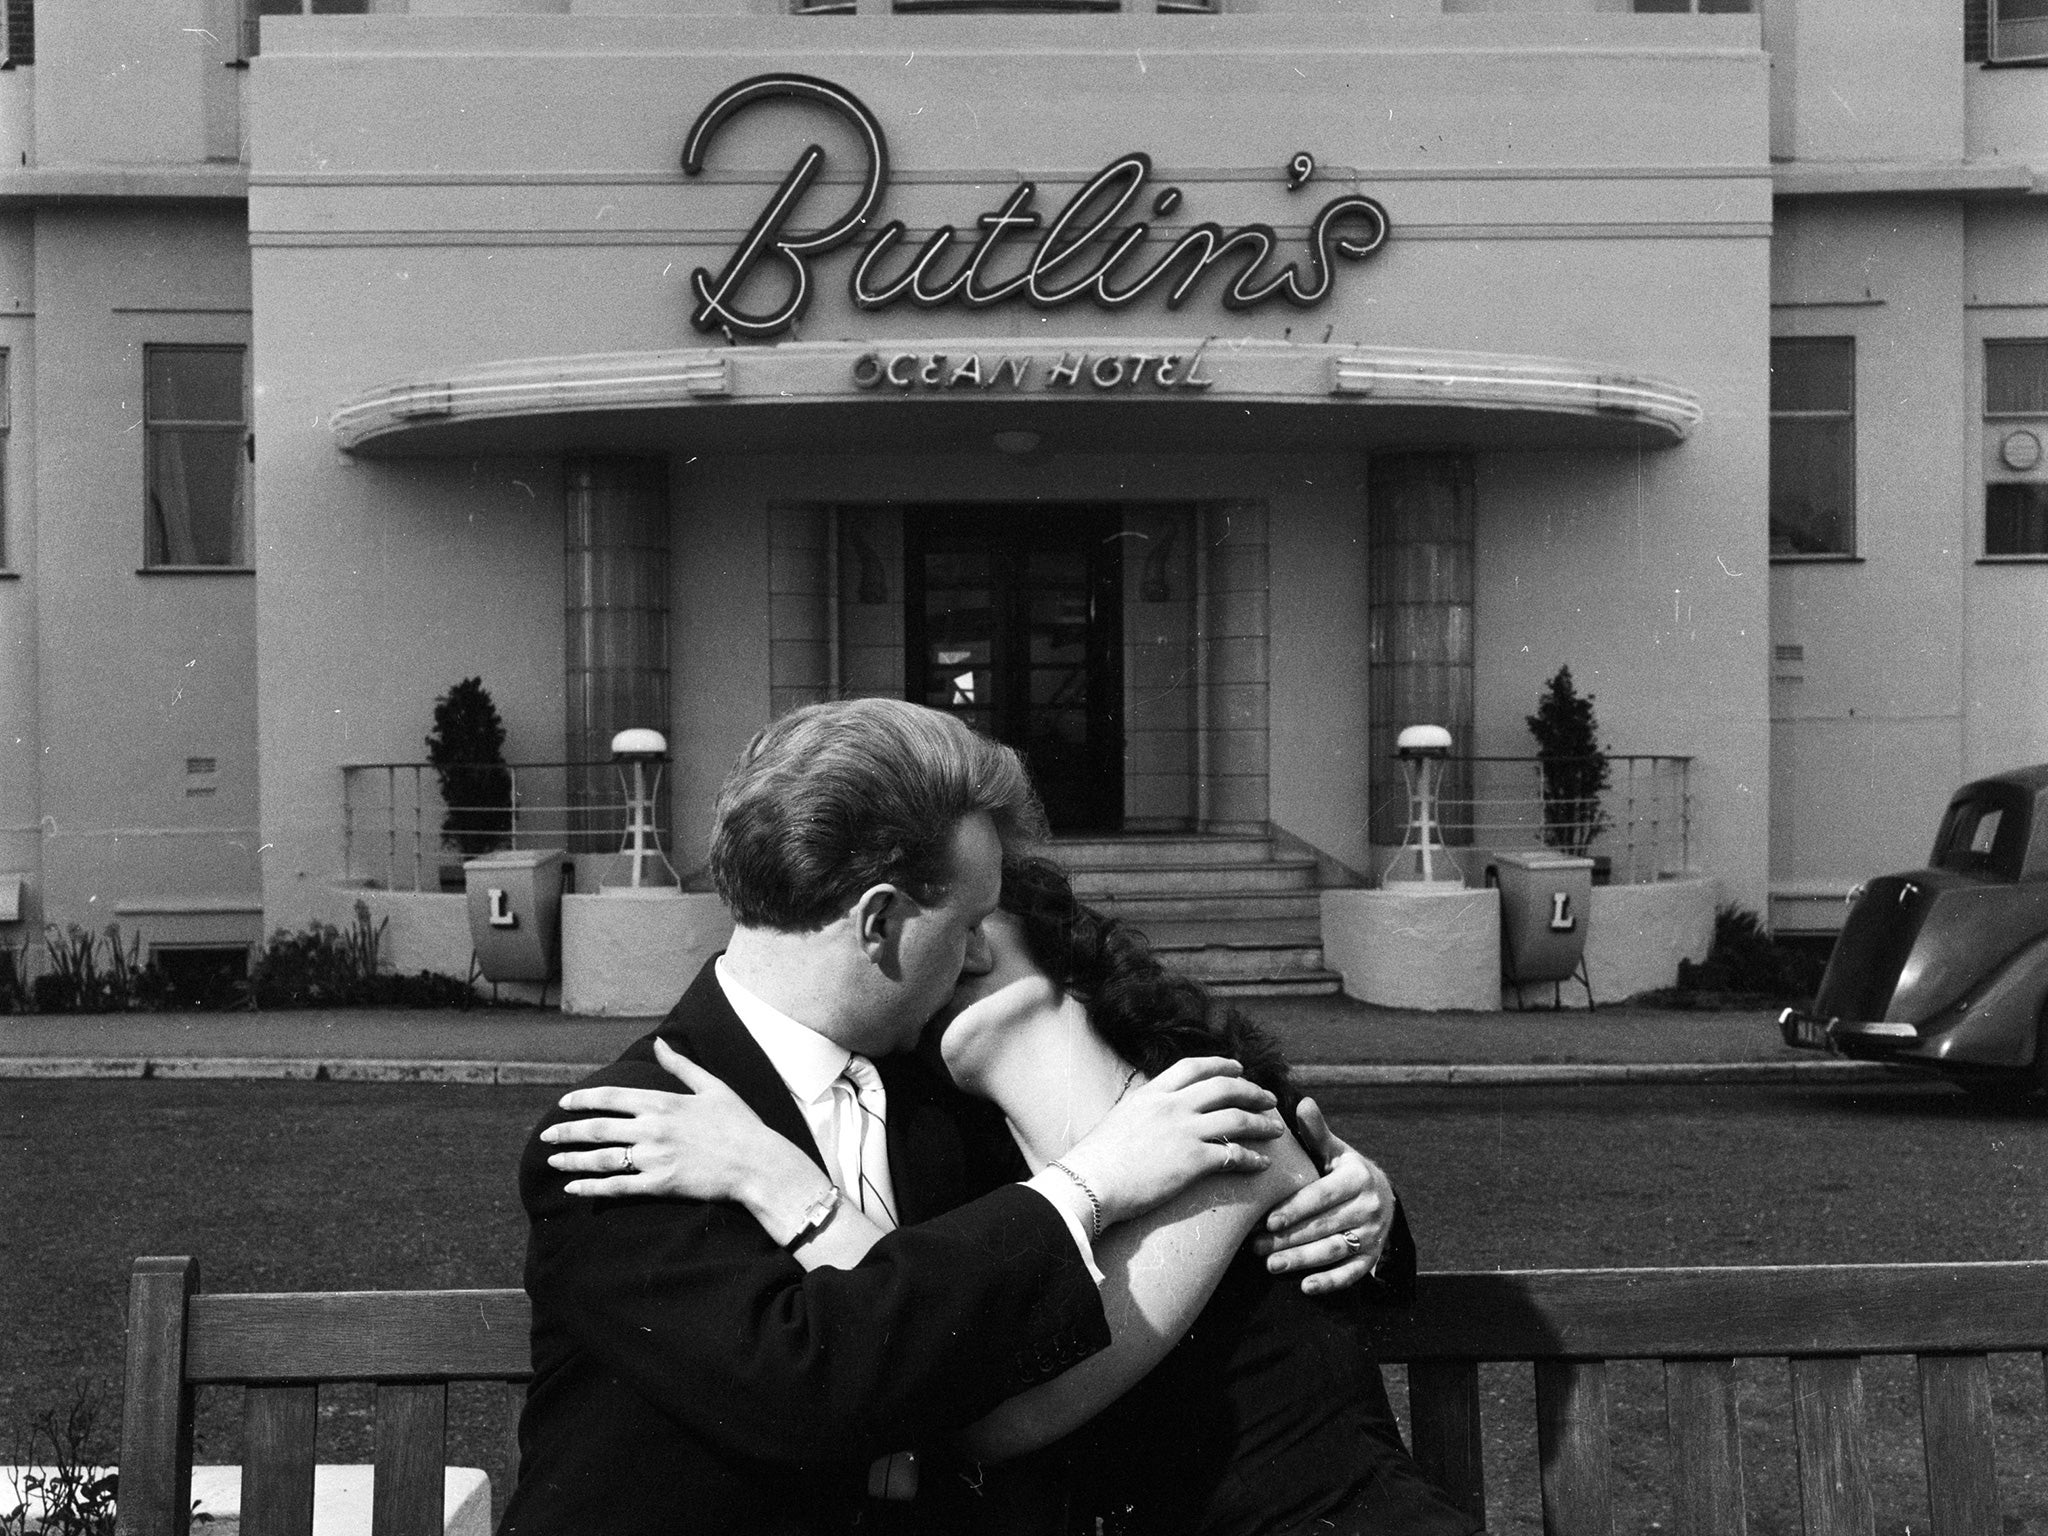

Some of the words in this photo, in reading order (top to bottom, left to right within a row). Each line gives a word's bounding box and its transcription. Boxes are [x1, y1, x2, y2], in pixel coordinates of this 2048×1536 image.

[682, 72, 1390, 335] Butlin's
[854, 353, 1030, 387] OCEAN
[1050, 352, 1212, 387] HOTEL
[488, 889, 514, 925] L
[1551, 892, 1574, 928] L
